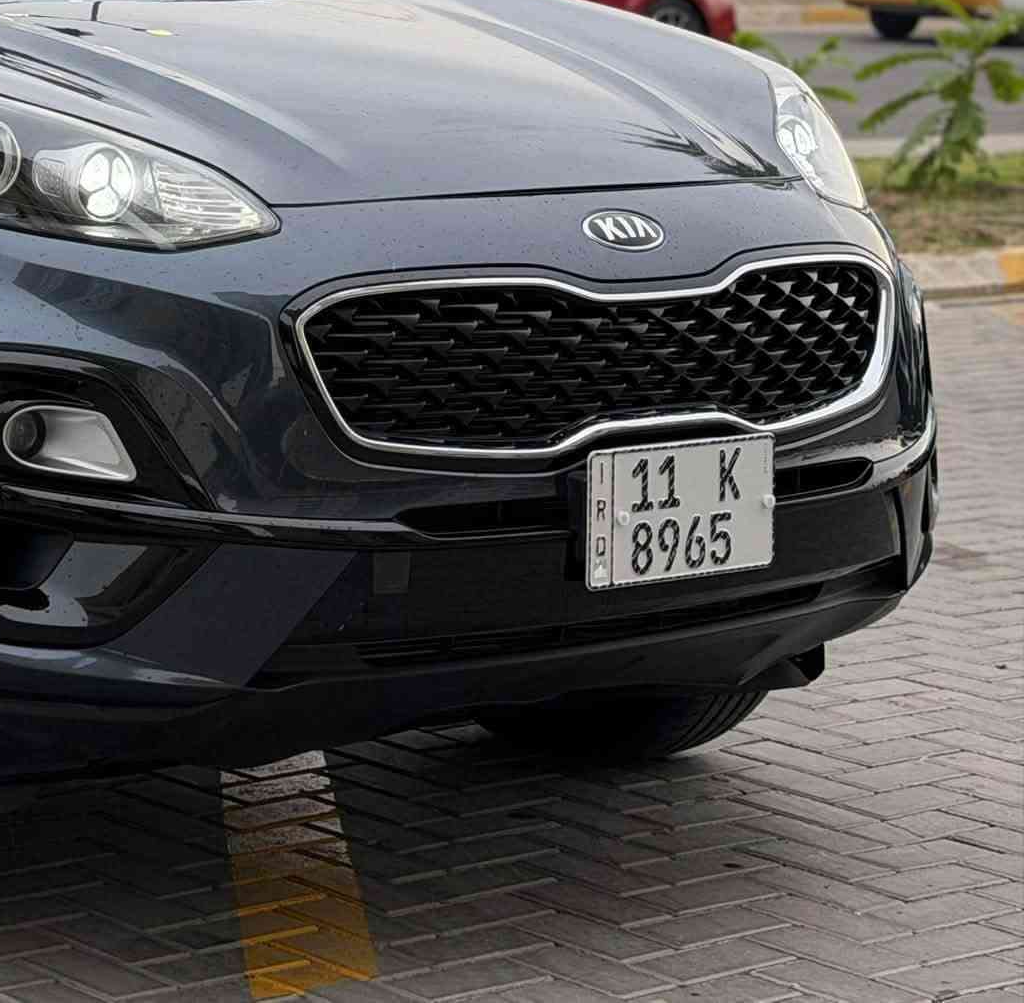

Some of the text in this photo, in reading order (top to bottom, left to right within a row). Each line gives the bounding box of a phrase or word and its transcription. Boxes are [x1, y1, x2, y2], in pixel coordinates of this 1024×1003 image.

[592, 215, 658, 241] KIA
[631, 454, 681, 513] 11
[719, 447, 742, 502] K
[631, 511, 732, 576] 8965
